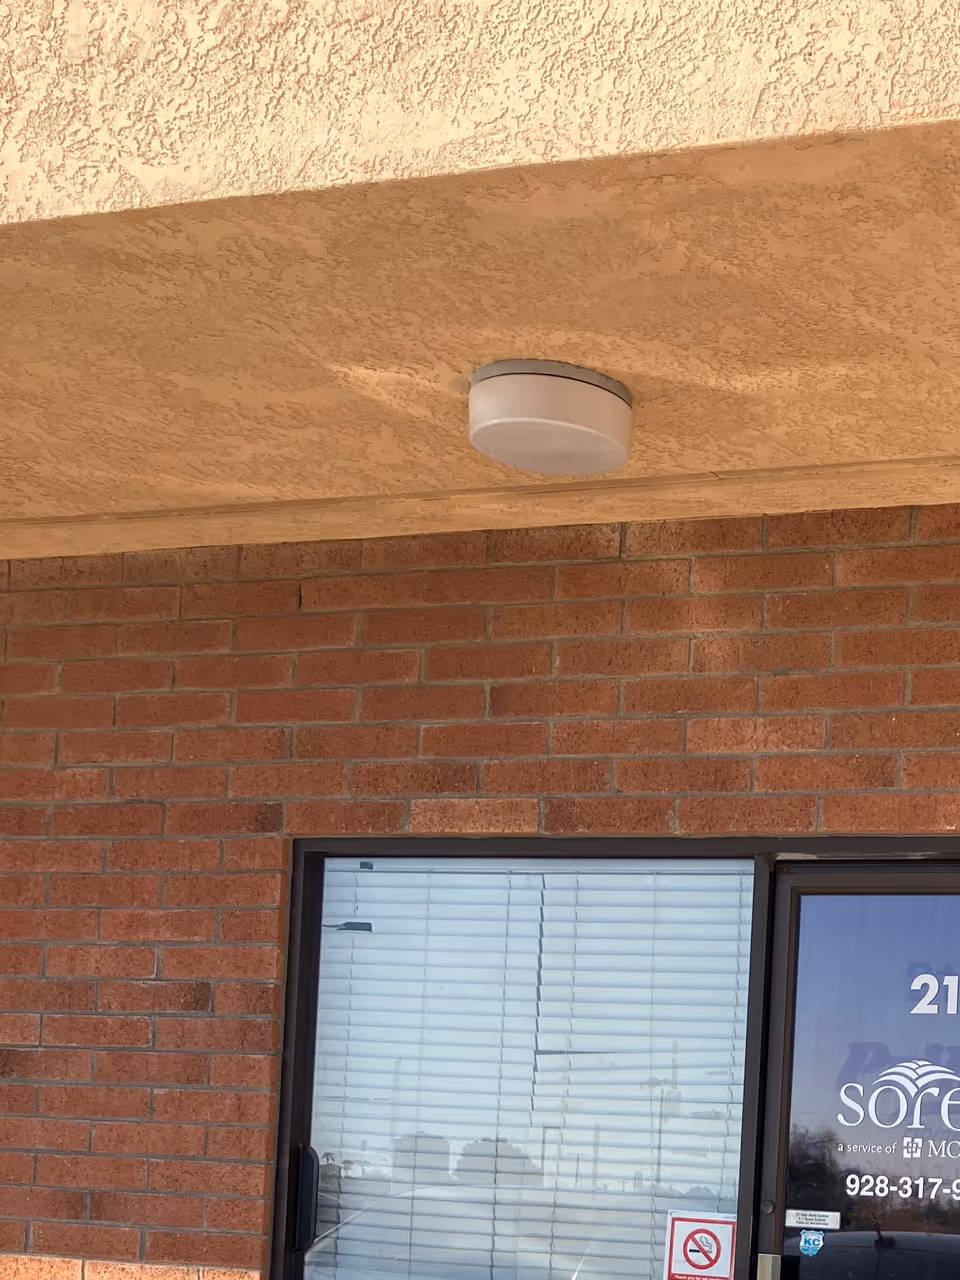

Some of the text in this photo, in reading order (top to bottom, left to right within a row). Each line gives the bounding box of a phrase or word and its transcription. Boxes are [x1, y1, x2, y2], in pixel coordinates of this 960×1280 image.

[910, 973, 959, 1014] 21
[837, 1143, 844, 1153] a
[846, 1142, 882, 1154] service
[885, 1142, 897, 1154] of
[804, 1238, 821, 1247] KC
